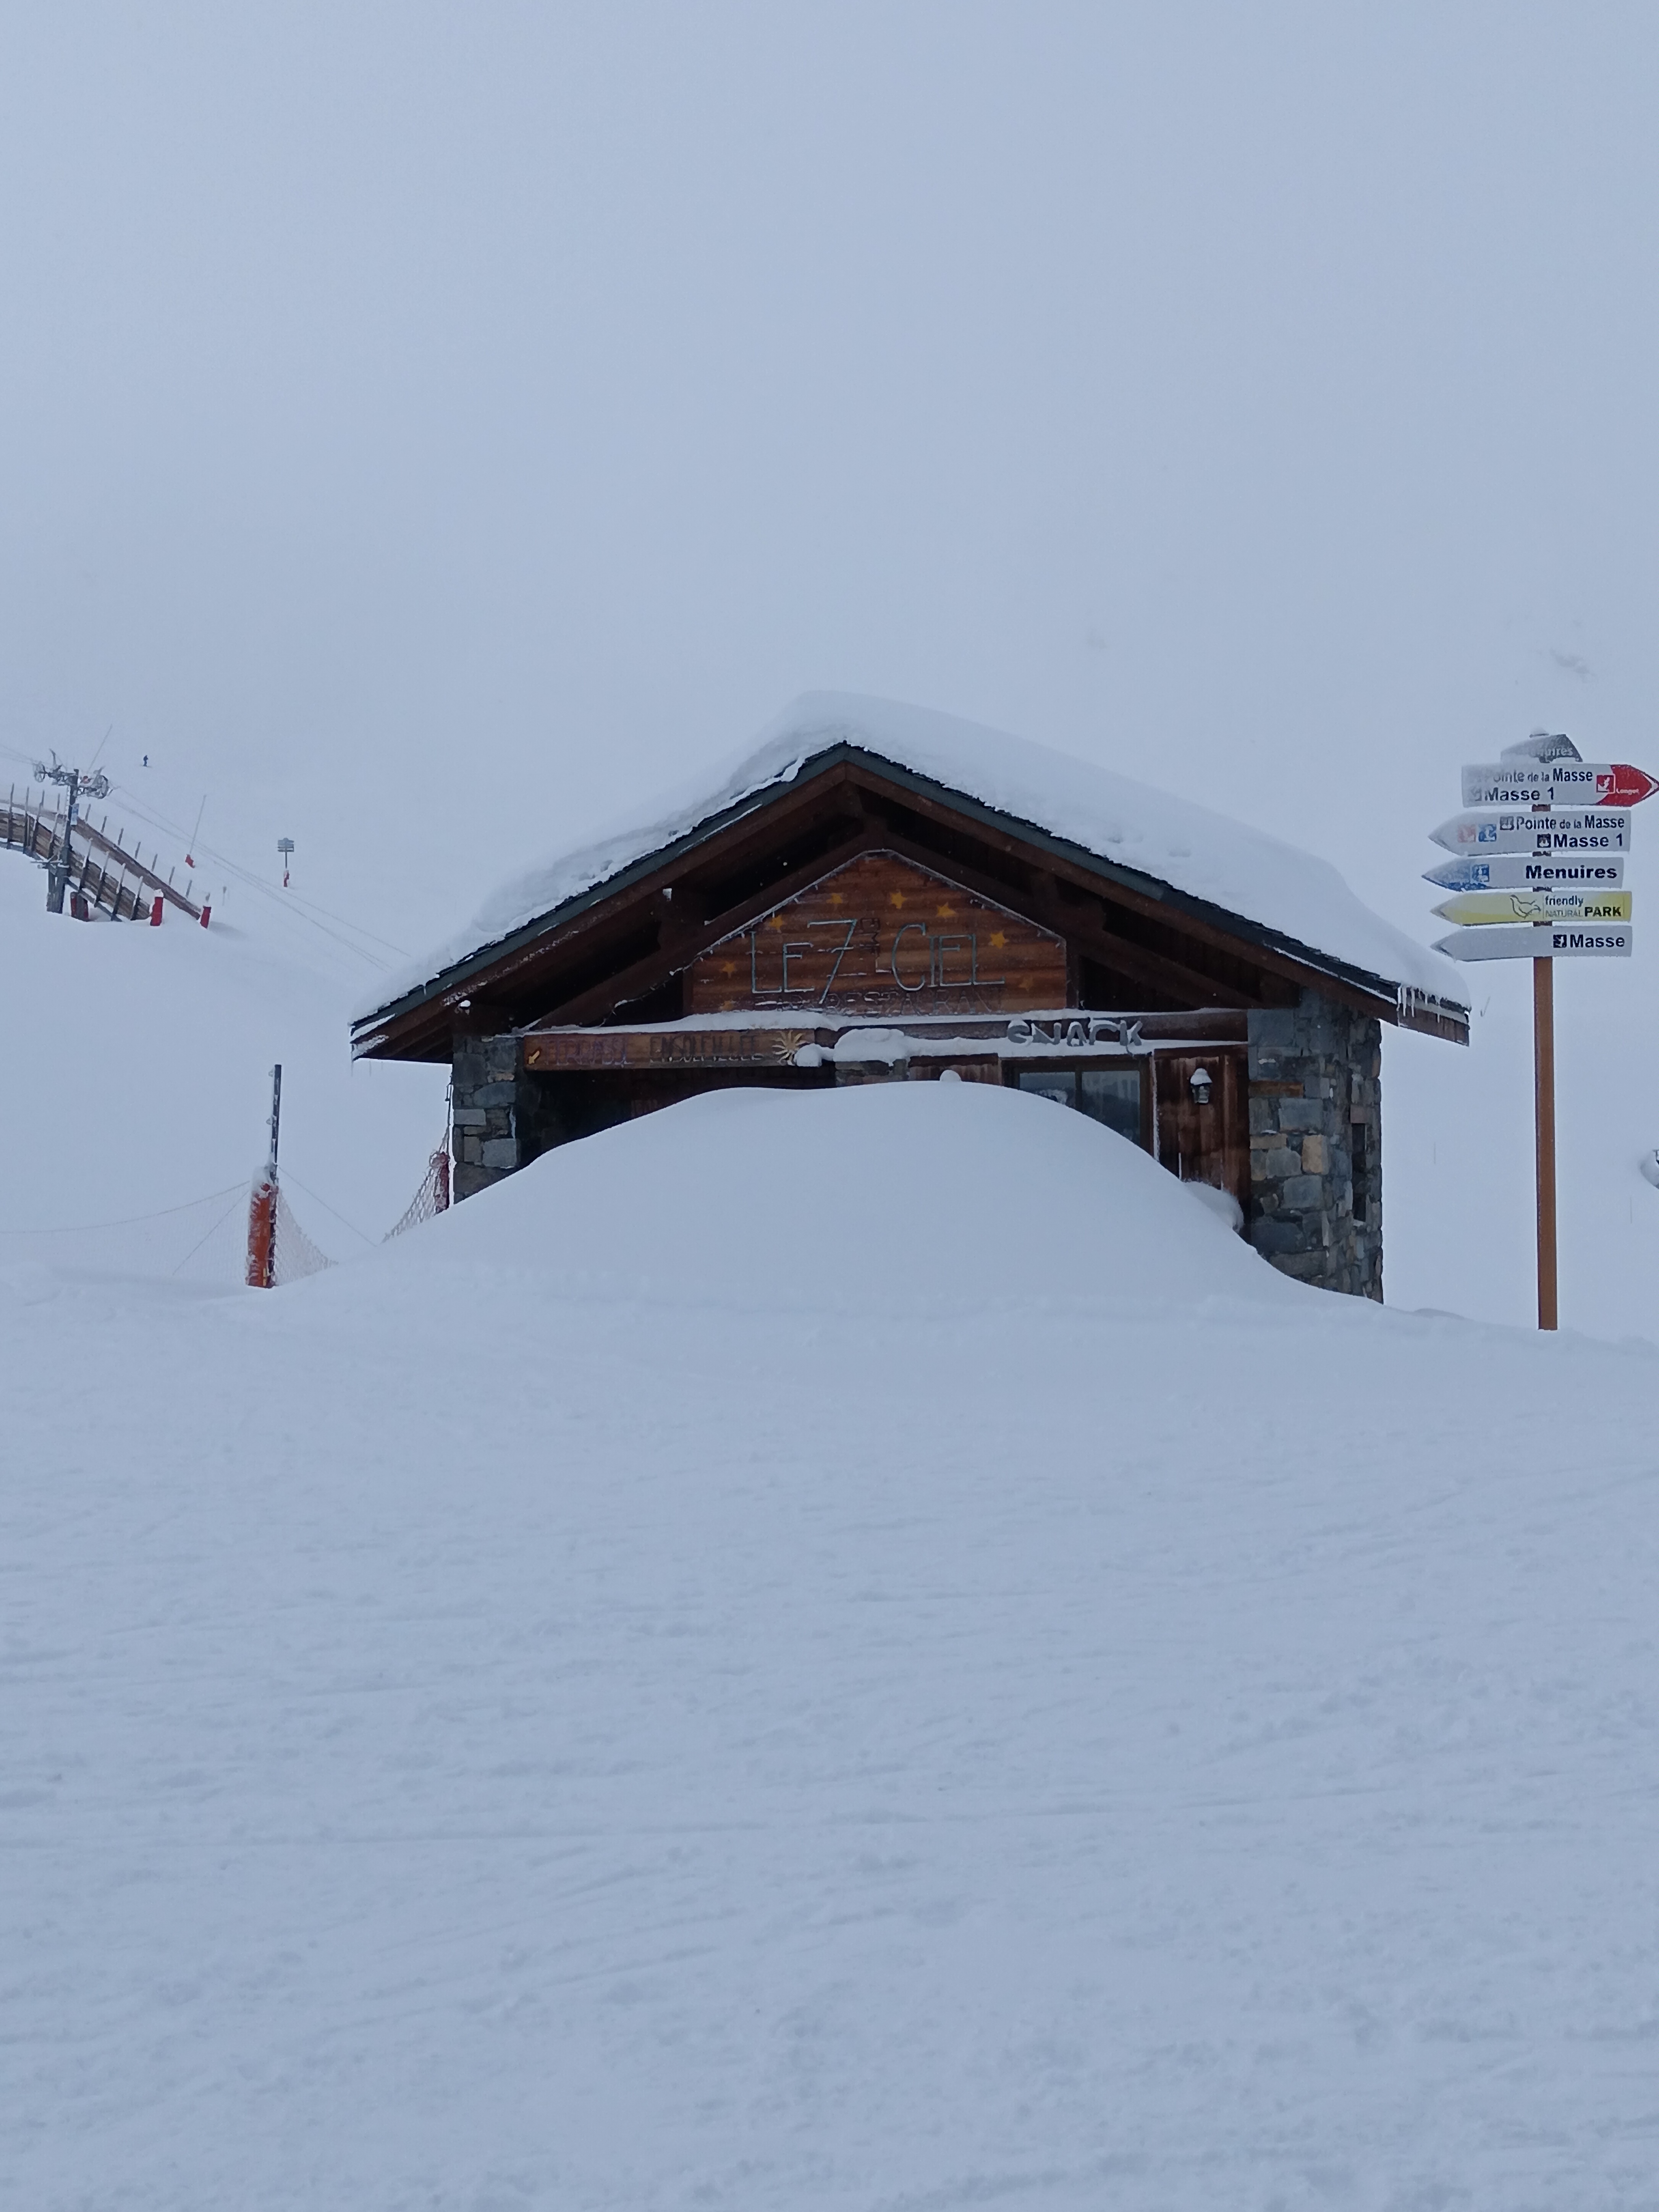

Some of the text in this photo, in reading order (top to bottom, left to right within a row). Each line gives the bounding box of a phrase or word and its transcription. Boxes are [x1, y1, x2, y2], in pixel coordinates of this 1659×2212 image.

[1528, 771, 1539, 783] de
[1541, 771, 1550, 782] la
[1553, 768, 1593, 782] Masse
[1484, 786, 1554, 801] Masse 1
[1516, 815, 1625, 830] Pointe de la Masse
[1554, 833, 1623, 847] Masse 1
[1526, 865, 1618, 879] Menuires
[1545, 895, 1584, 907] friendly
[1545, 906, 1622, 917] NATURAL PARK
[1570, 934, 1625, 948] Masse
[750, 931, 815, 994] LE
[807, 918, 859, 1005] 7
[891, 922, 1006, 992] CIEL
[1007, 1020, 1143, 1047] SNACK
